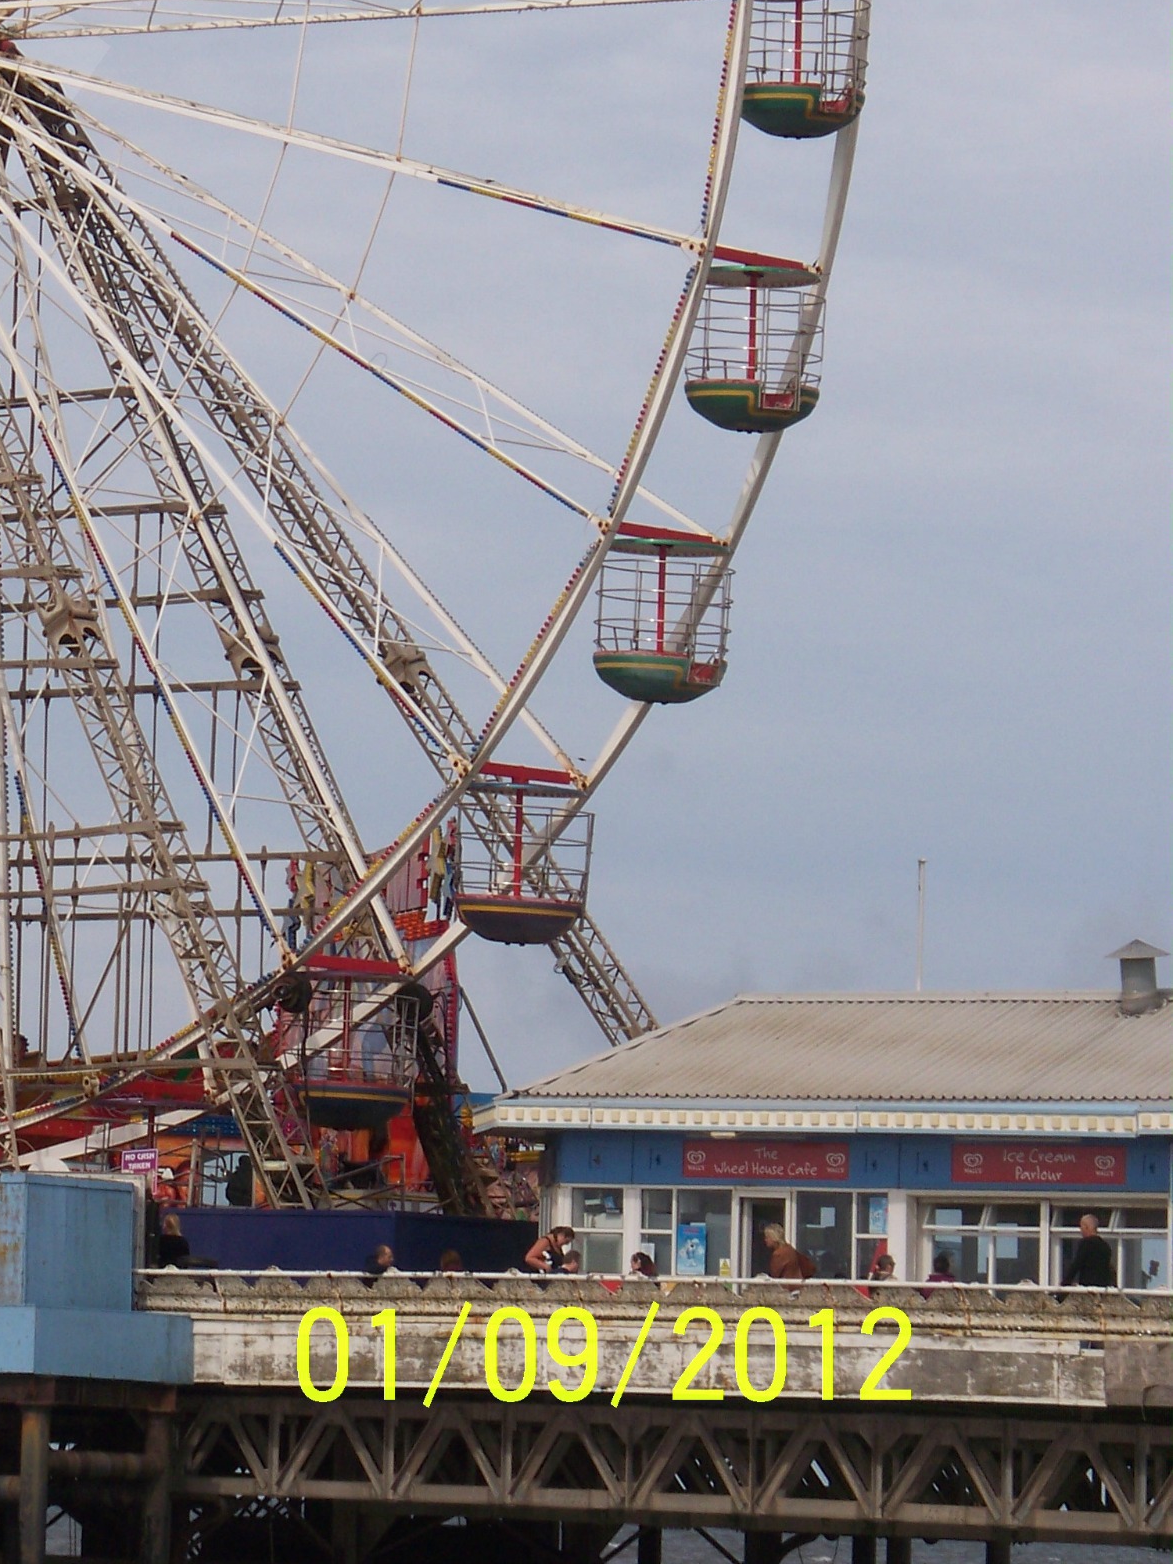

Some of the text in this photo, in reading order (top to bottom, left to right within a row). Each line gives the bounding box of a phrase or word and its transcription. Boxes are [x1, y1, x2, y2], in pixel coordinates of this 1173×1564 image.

[755, 1147, 778, 1161] The
[1003, 1148, 1076, 1164] Ice Cream
[714, 1161, 818, 1177] Wheel House Cafe
[1015, 1166, 1063, 1181] Parlour
